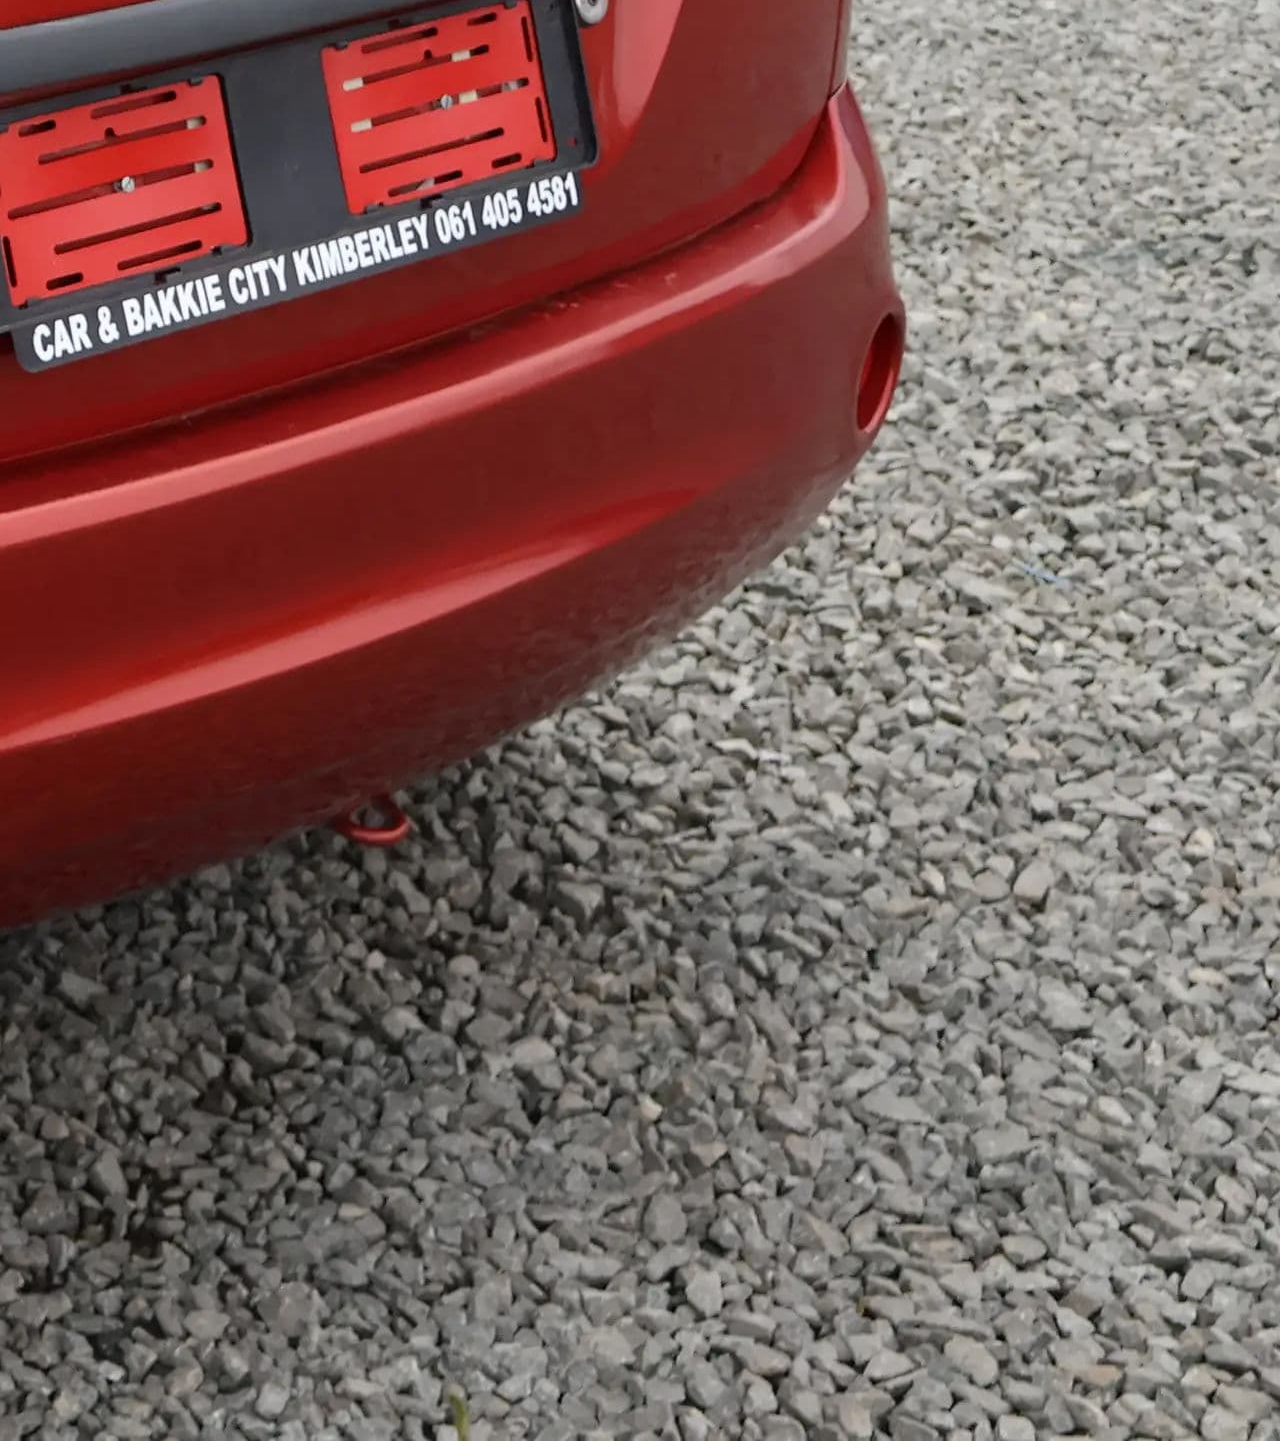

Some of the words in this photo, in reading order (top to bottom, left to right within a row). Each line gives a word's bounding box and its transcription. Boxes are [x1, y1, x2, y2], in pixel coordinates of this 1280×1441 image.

[32, 313, 92, 362] CAR
[97, 306, 120, 344] &
[121, 277, 227, 336] BAKKIE
[228, 254, 287, 304] CITY
[291, 213, 431, 286] KIMBERLEY
[434, 200, 479, 245] 061
[481, 188, 522, 232] 405
[526, 170, 579, 218] 4581
